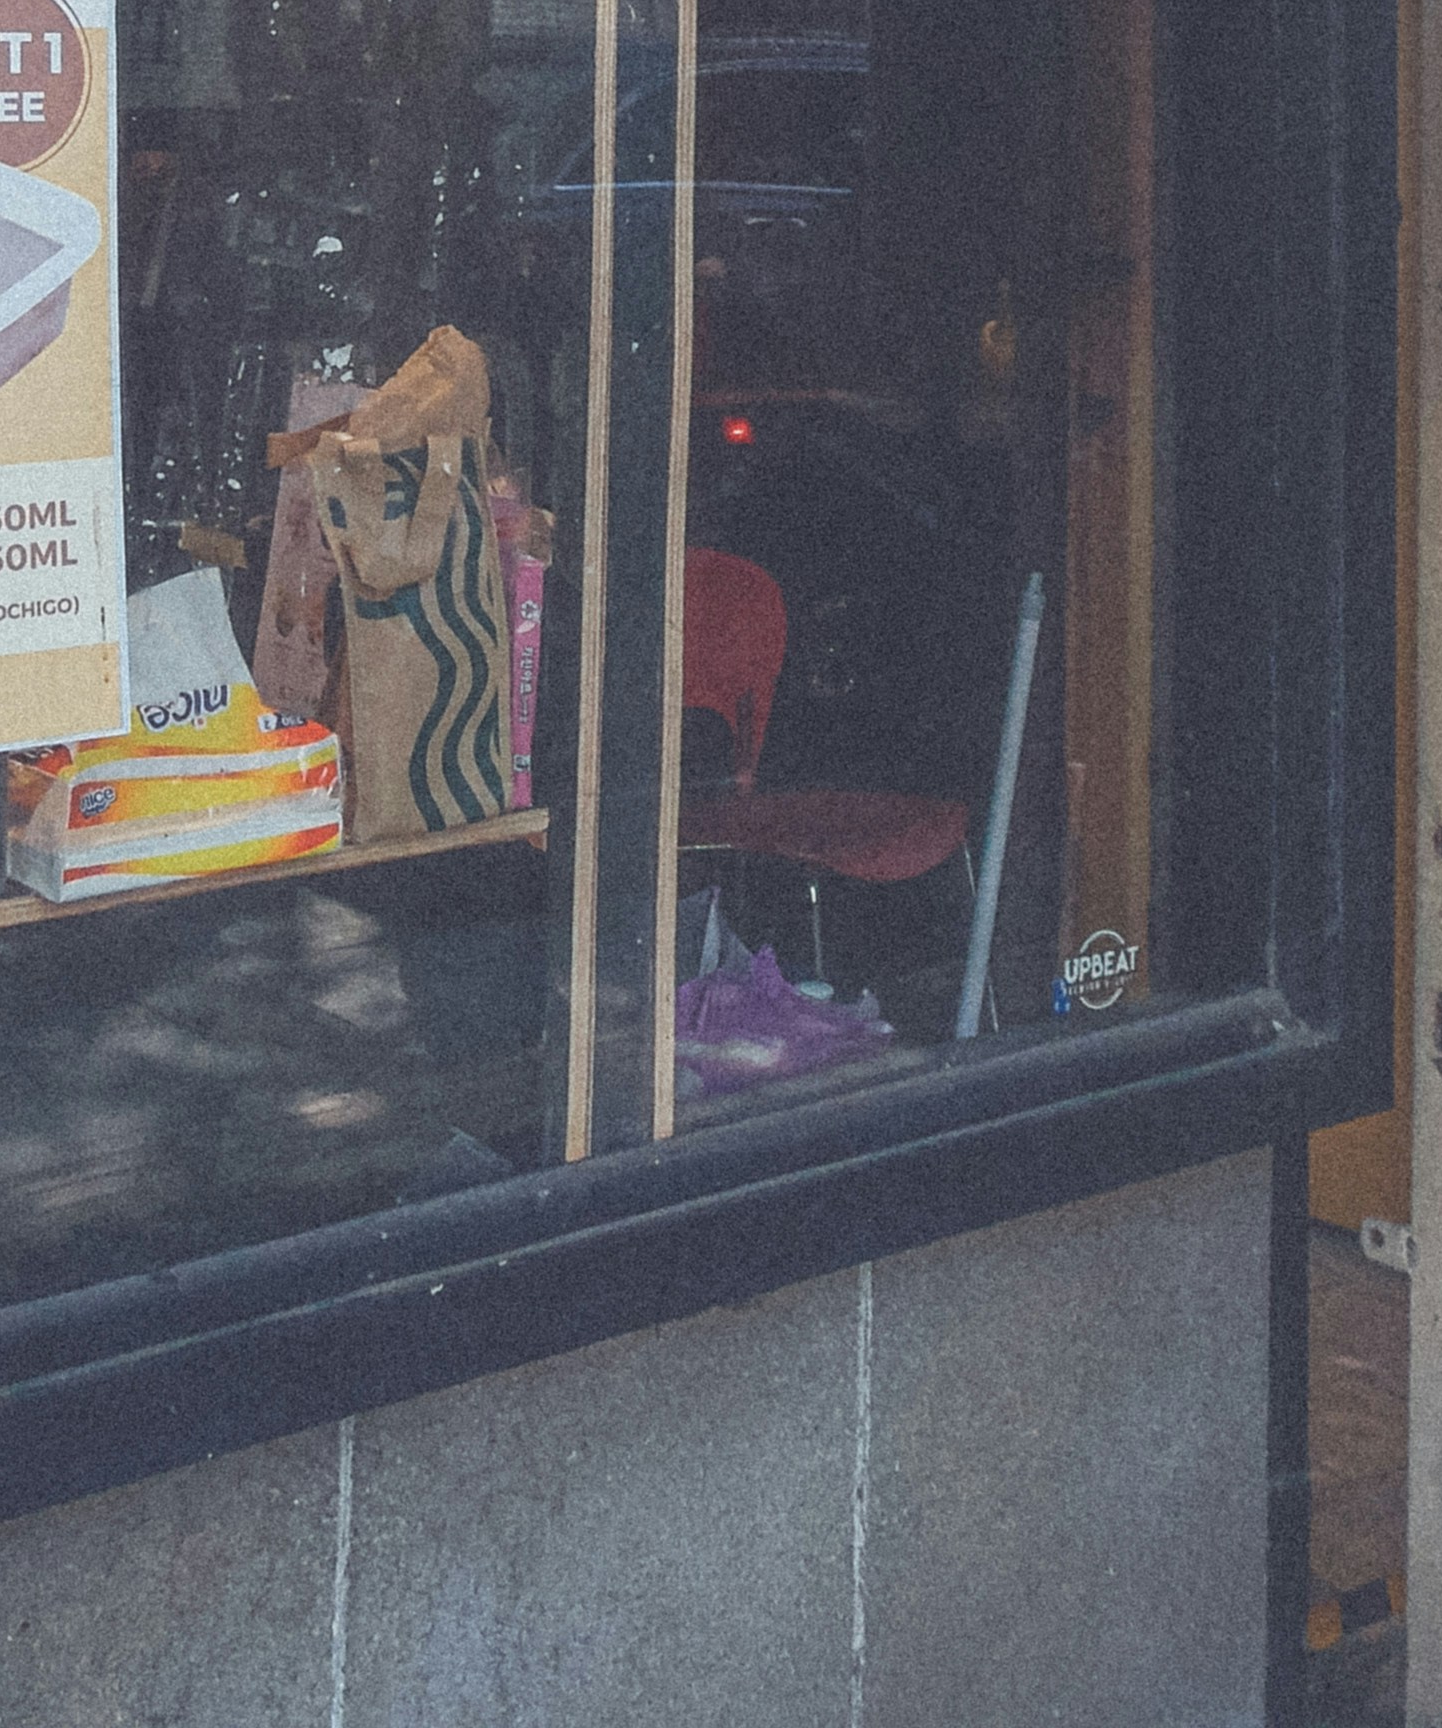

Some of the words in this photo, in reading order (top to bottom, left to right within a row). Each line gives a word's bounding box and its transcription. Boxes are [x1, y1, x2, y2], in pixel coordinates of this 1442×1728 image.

[41, 31, 64, 73] 1
[144, 685, 228, 730] nice
[81, 788, 115, 809] nice
[1064, 945, 1139, 984] UPBEAT
